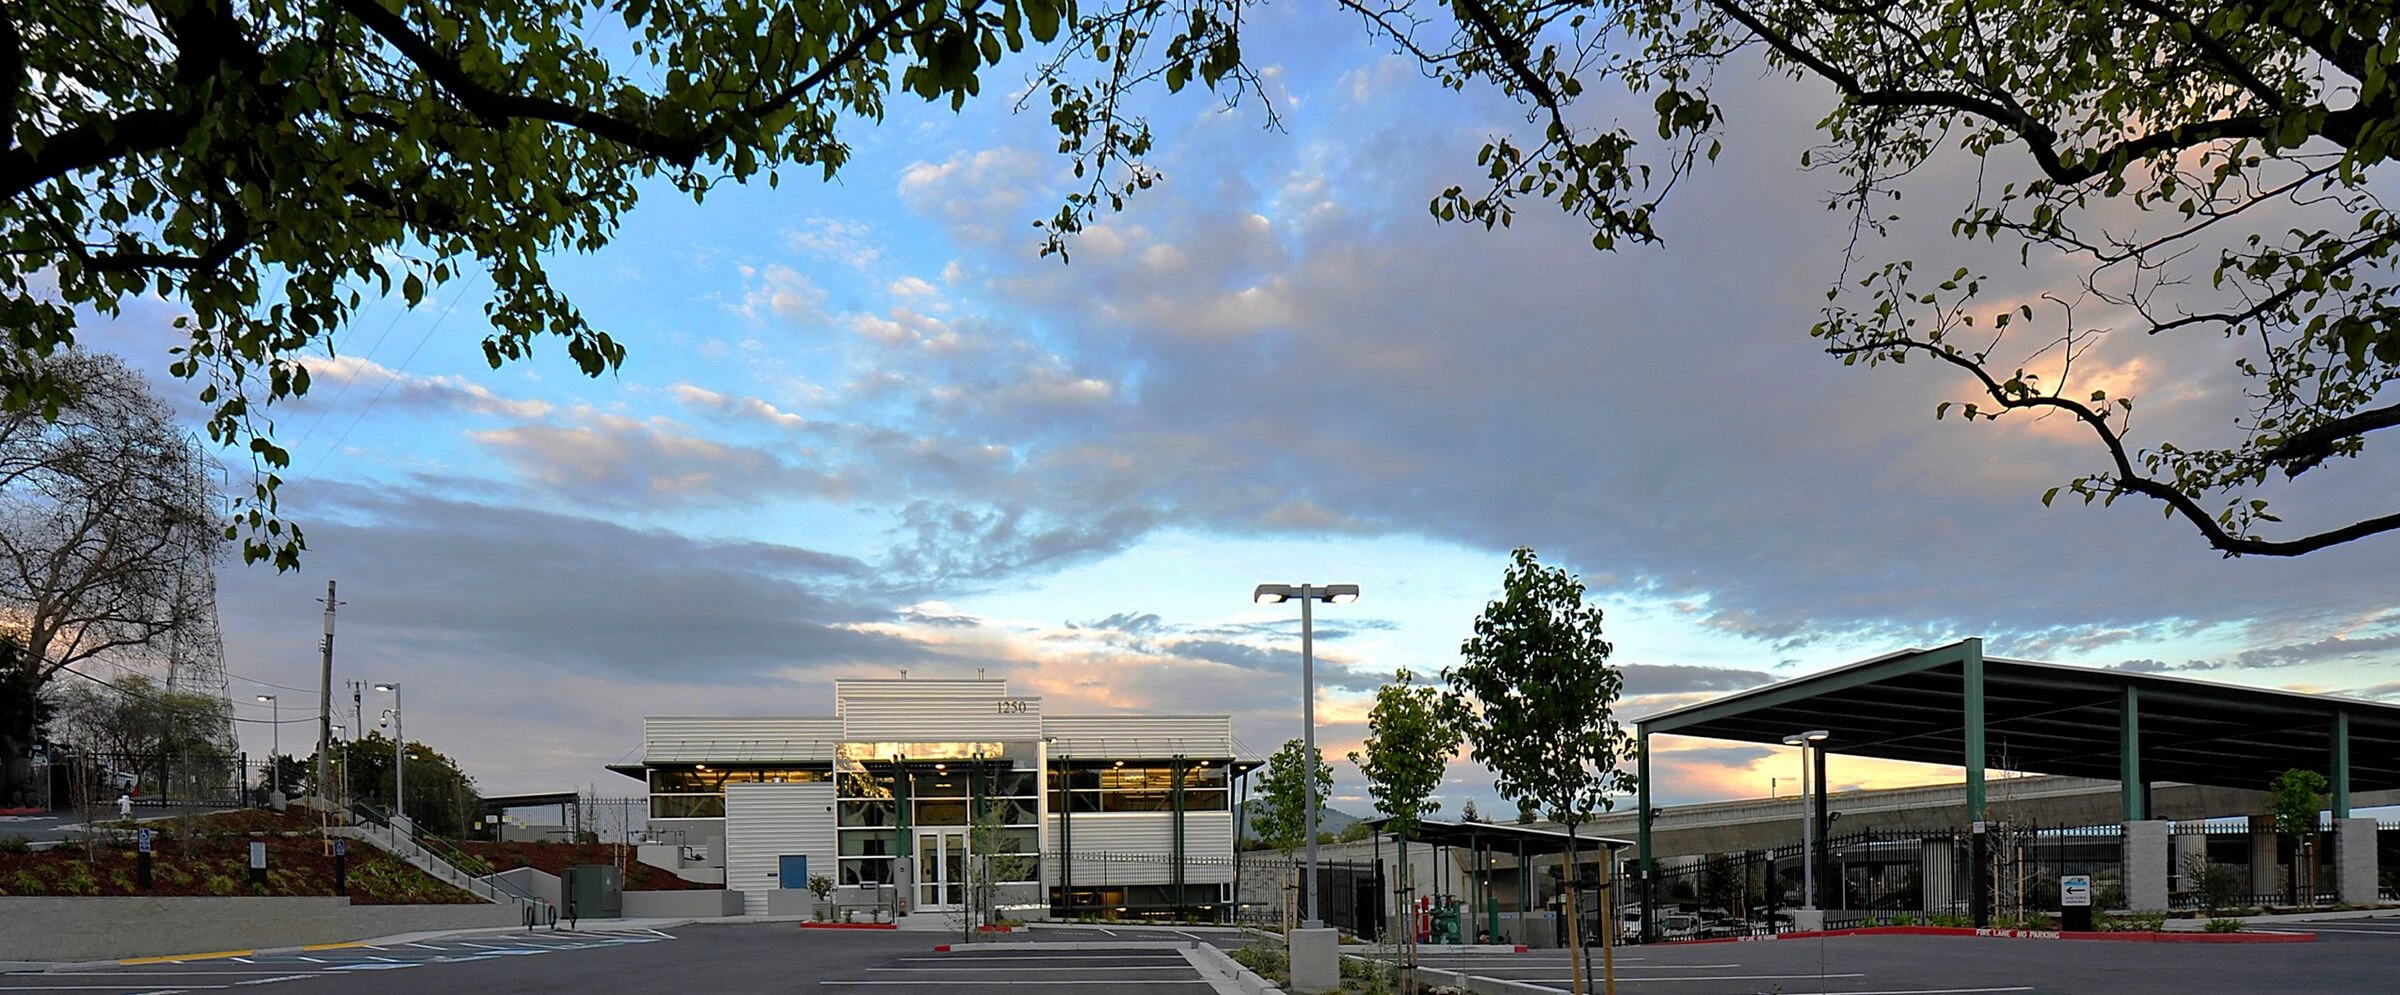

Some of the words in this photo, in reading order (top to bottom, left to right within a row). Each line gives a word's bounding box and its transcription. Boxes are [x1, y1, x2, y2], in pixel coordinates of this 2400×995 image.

[997, 701, 1027, 714] 1250
[1976, 928, 1991, 936] FIRE
[1993, 929, 2011, 937] LANE
[2017, 930, 2027, 938] NO
[2029, 931, 2060, 939] PARKING
